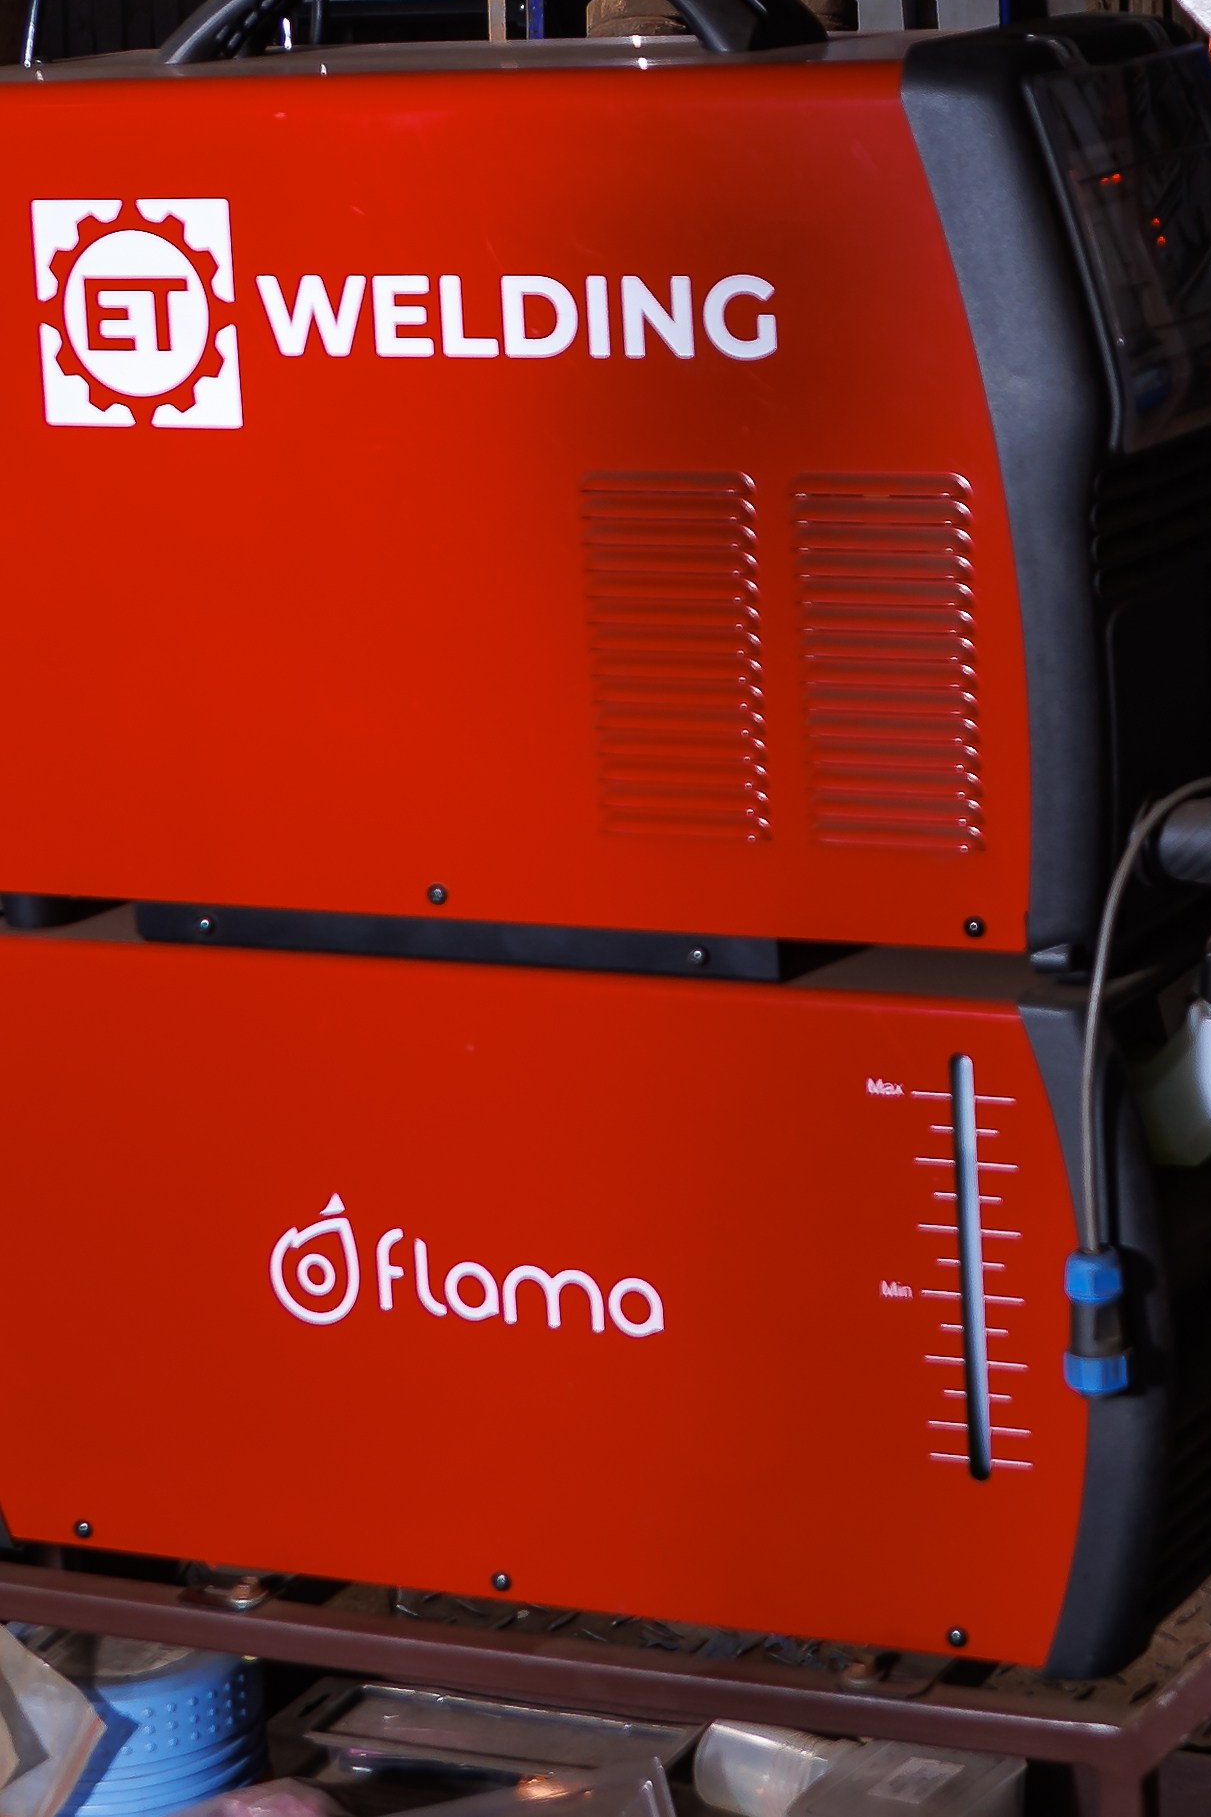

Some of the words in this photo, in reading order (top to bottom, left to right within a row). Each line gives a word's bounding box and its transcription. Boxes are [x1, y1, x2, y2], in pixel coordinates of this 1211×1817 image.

[83, 275, 189, 352] ET
[255, 274, 778, 360] WELDING
[865, 1077, 905, 1096] Max
[375, 1227, 665, 1338] flama
[880, 1280, 913, 1298] Min
